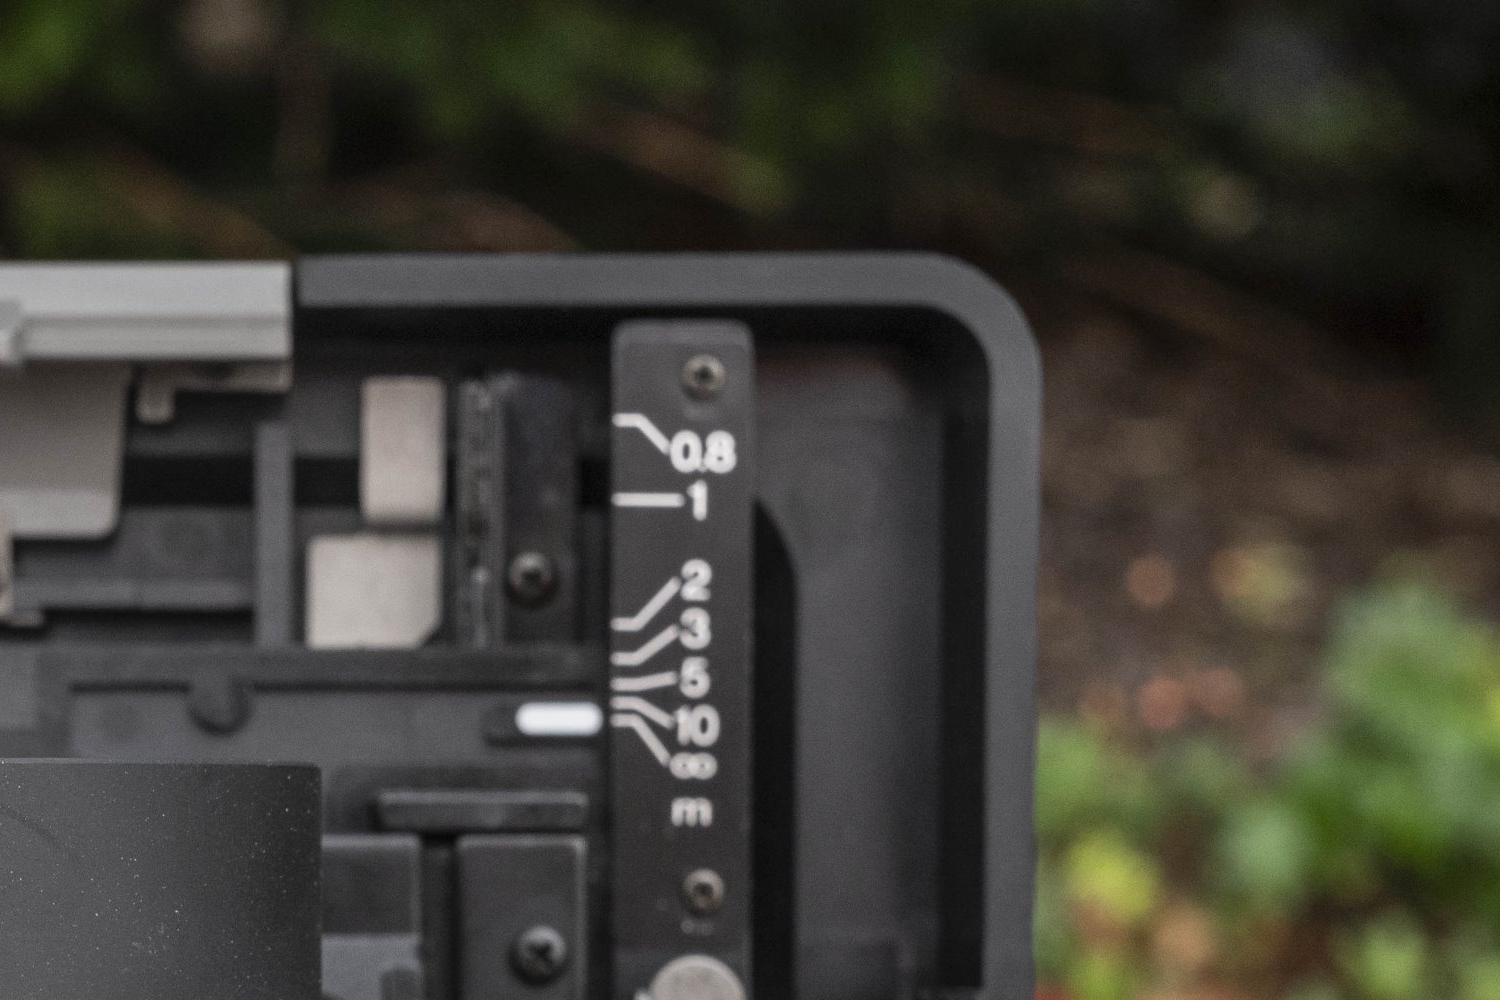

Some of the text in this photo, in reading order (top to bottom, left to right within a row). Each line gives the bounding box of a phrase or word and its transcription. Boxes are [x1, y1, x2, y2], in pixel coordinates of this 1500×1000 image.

[670, 430, 737, 474] 0.8
[687, 479, 708, 521] 1
[680, 558, 712, 602] 2
[679, 607, 712, 650] 3
[674, 703, 721, 748] 10
[671, 798, 713, 827] m
